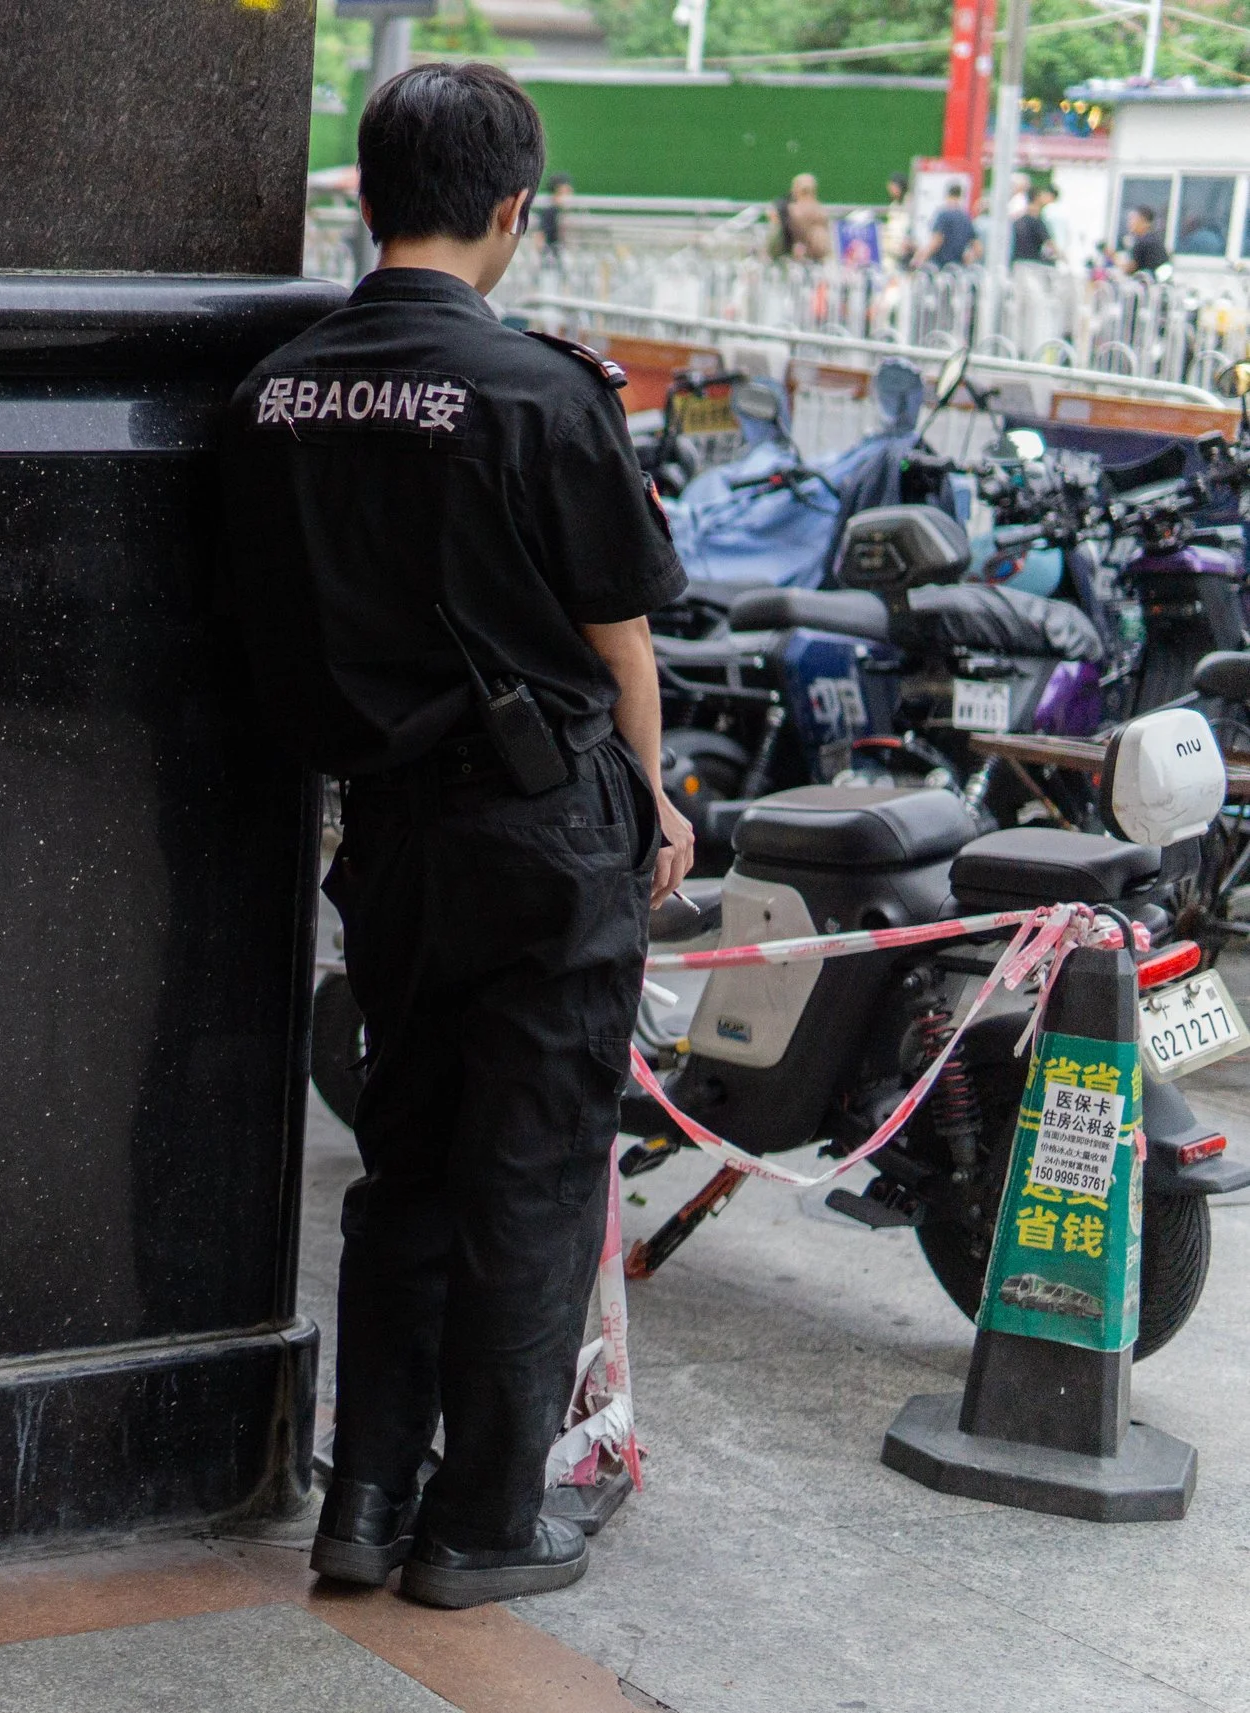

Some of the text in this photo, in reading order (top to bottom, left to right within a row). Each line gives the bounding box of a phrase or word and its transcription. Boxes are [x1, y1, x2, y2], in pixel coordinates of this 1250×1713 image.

[1151, 1006, 1231, 1062] G27277
[1056, 1090, 1111, 1117] 医保卡
[1043, 1108, 1117, 1139] 住房公积金
[1040, 1142, 1108, 1163] 价格冰点大量收单
[1044, 1155, 1099, 1175] 24小时财富热线
[1035, 1165, 1106, 1192] 150 9995 3761
[1016, 1205, 1106, 1258] 省钱
